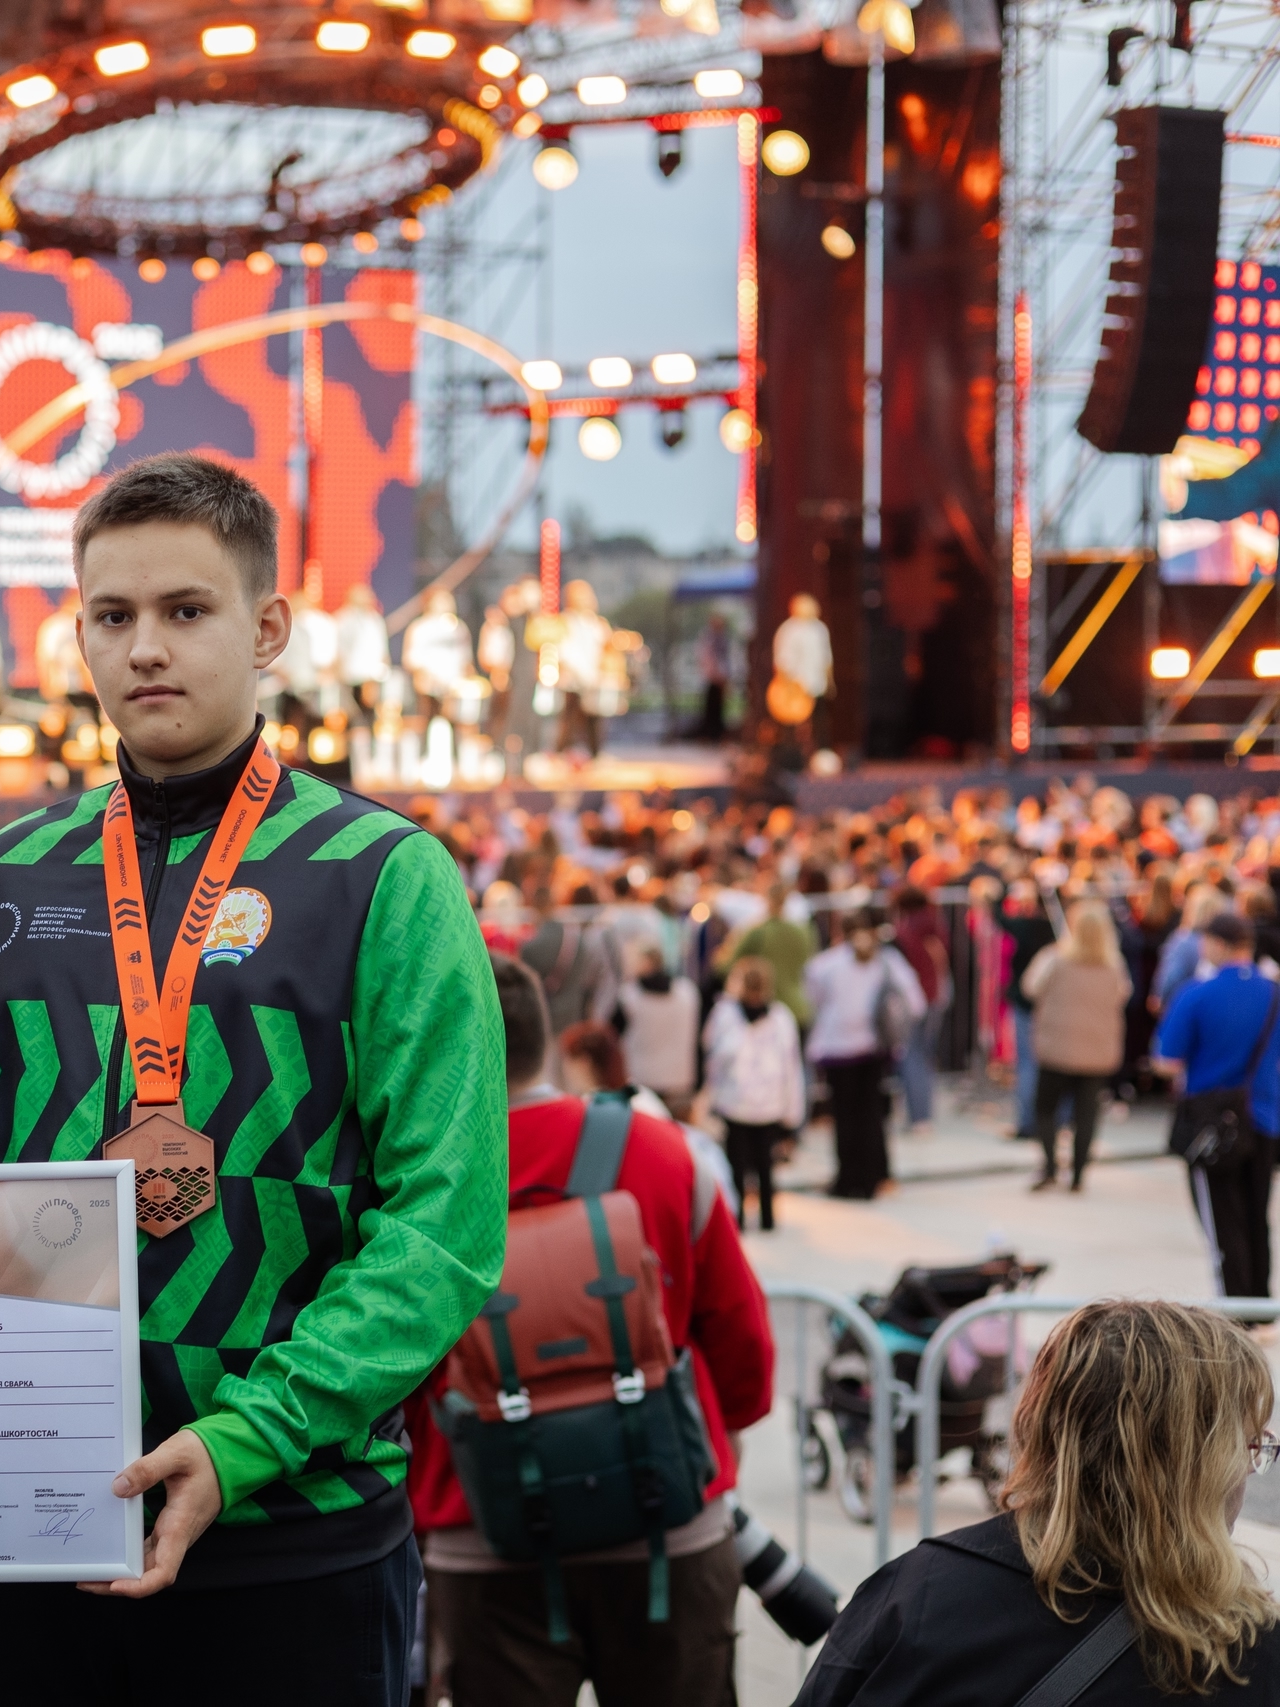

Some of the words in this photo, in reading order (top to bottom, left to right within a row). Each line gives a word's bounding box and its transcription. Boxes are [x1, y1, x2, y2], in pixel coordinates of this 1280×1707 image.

[228, 809, 247, 842] ОСНОВНОЙ
[116, 833, 124, 852] ЗАЧЕТ
[219, 843, 232, 863] ЗАЧЕТ
[117, 852, 128, 886] ОСНОВНОЙ
[36, 906, 86, 914] ВСЕРОССИЙСКОЕ
[38, 926, 112, 938] ПРОФЕССИОНАЛЬНОМУ
[40, 1198, 82, 1250] ПРОФЕССИОНАЛЫ
